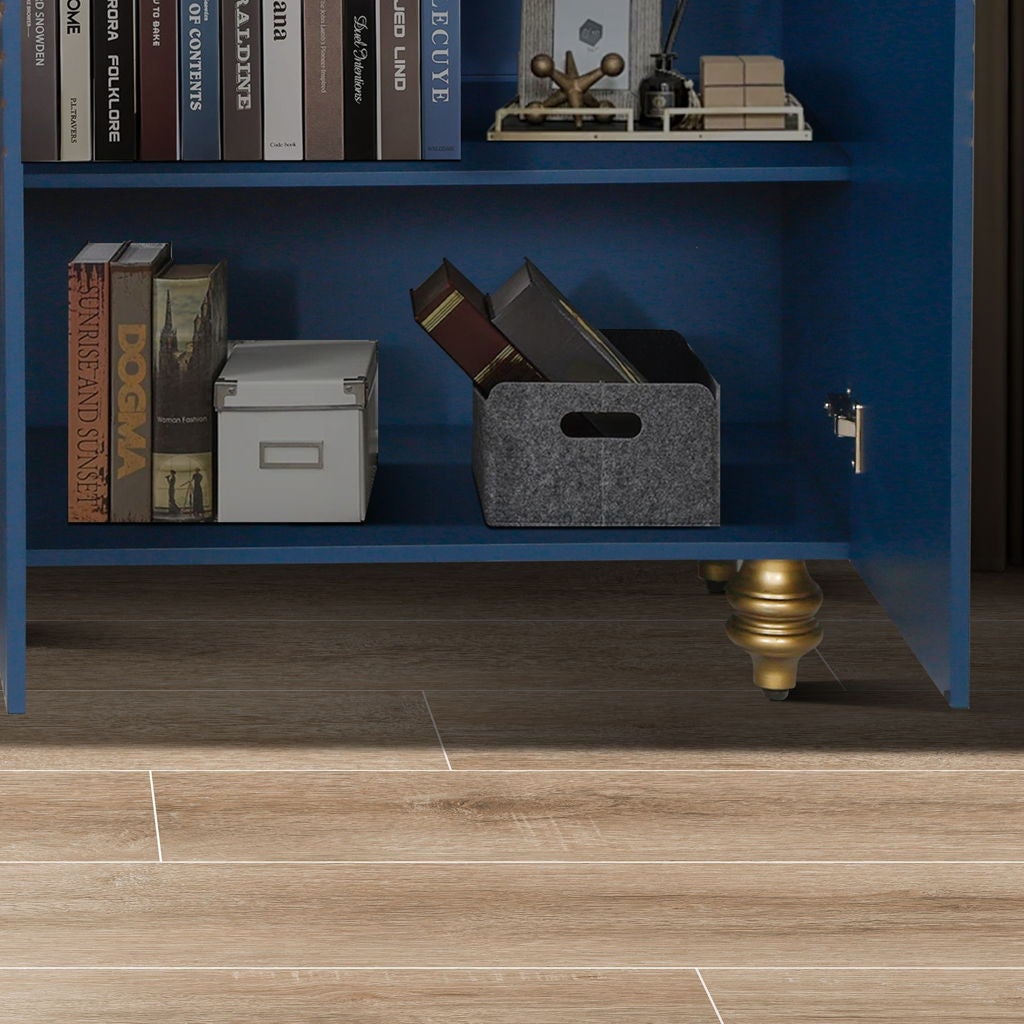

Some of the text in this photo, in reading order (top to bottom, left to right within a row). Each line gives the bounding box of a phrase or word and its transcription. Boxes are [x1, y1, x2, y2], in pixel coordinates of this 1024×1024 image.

[35, 12, 45, 66] SNOWDEN
[153, 7, 160, 18] TO
[189, 3, 201, 24] OF
[107, 55, 120, 142] FOLKLORE
[189, 28, 202, 111] CONTENTS
[394, 47, 406, 91] LIND
[77, 286, 100, 507] SUNRISE AND SUNSET
[117, 324, 146, 479] DOGMA
